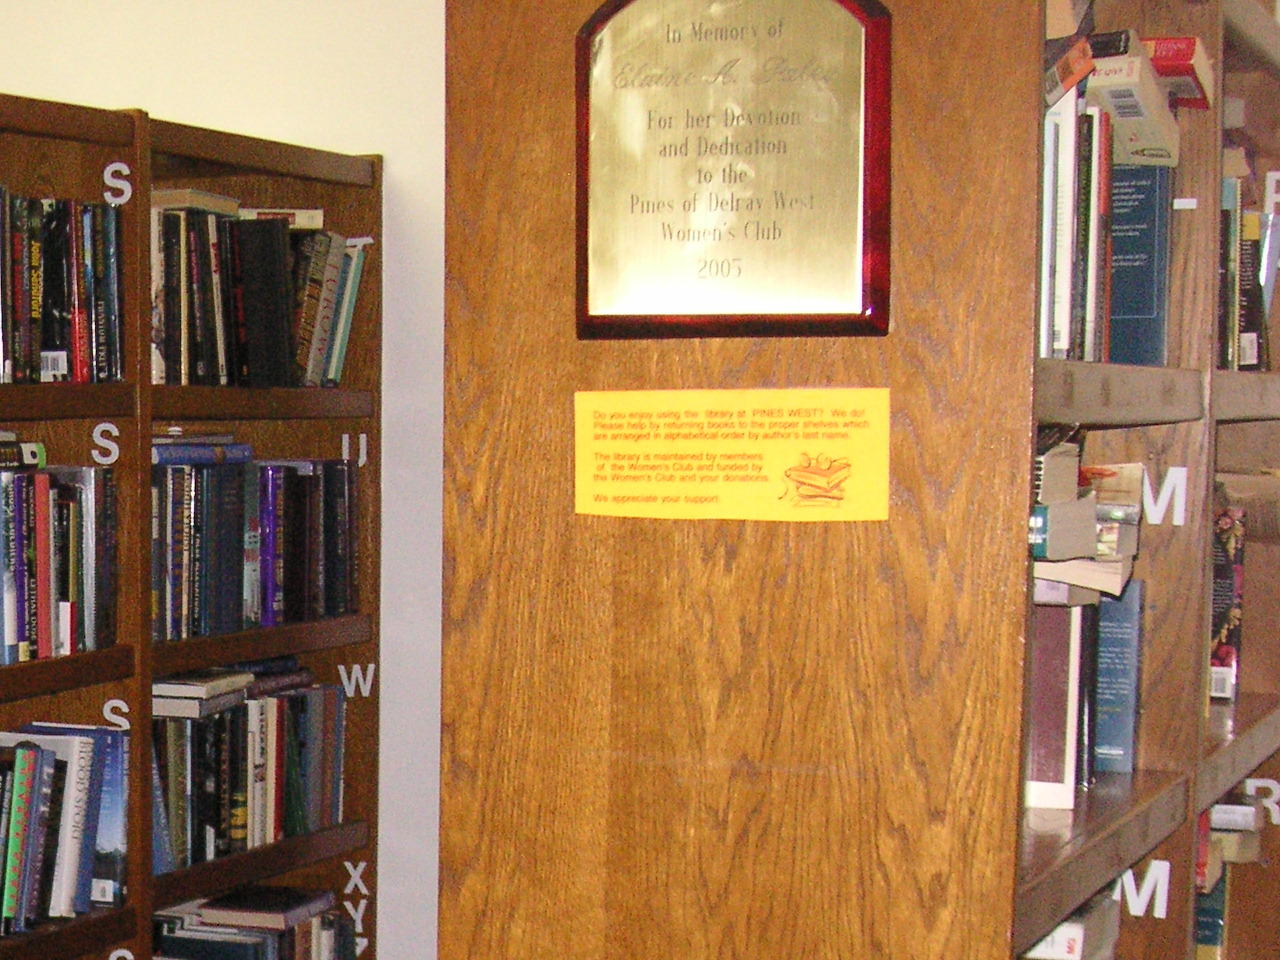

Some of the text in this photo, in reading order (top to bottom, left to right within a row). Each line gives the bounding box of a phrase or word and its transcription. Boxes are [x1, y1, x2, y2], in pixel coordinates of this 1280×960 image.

[666, 17, 784, 43] In Memory of
[648, 107, 801, 130] For her Devotion
[659, 136, 787, 157] and Dedication
[103, 161, 132, 205] S
[697, 163, 747, 184] to the
[630, 190, 815, 214] Pines of Delray West
[662, 221, 783, 242] Women's Club
[91, 422, 120, 466] S
[1143, 466, 1188, 526] M
[337, 663, 376, 698] W
[102, 699, 131, 732] S
[71, 740, 89, 841] BLOOD SPORT
[344, 861, 369, 896] X
[1112, 859, 1171, 919] M
[344, 899, 367, 933] Y
